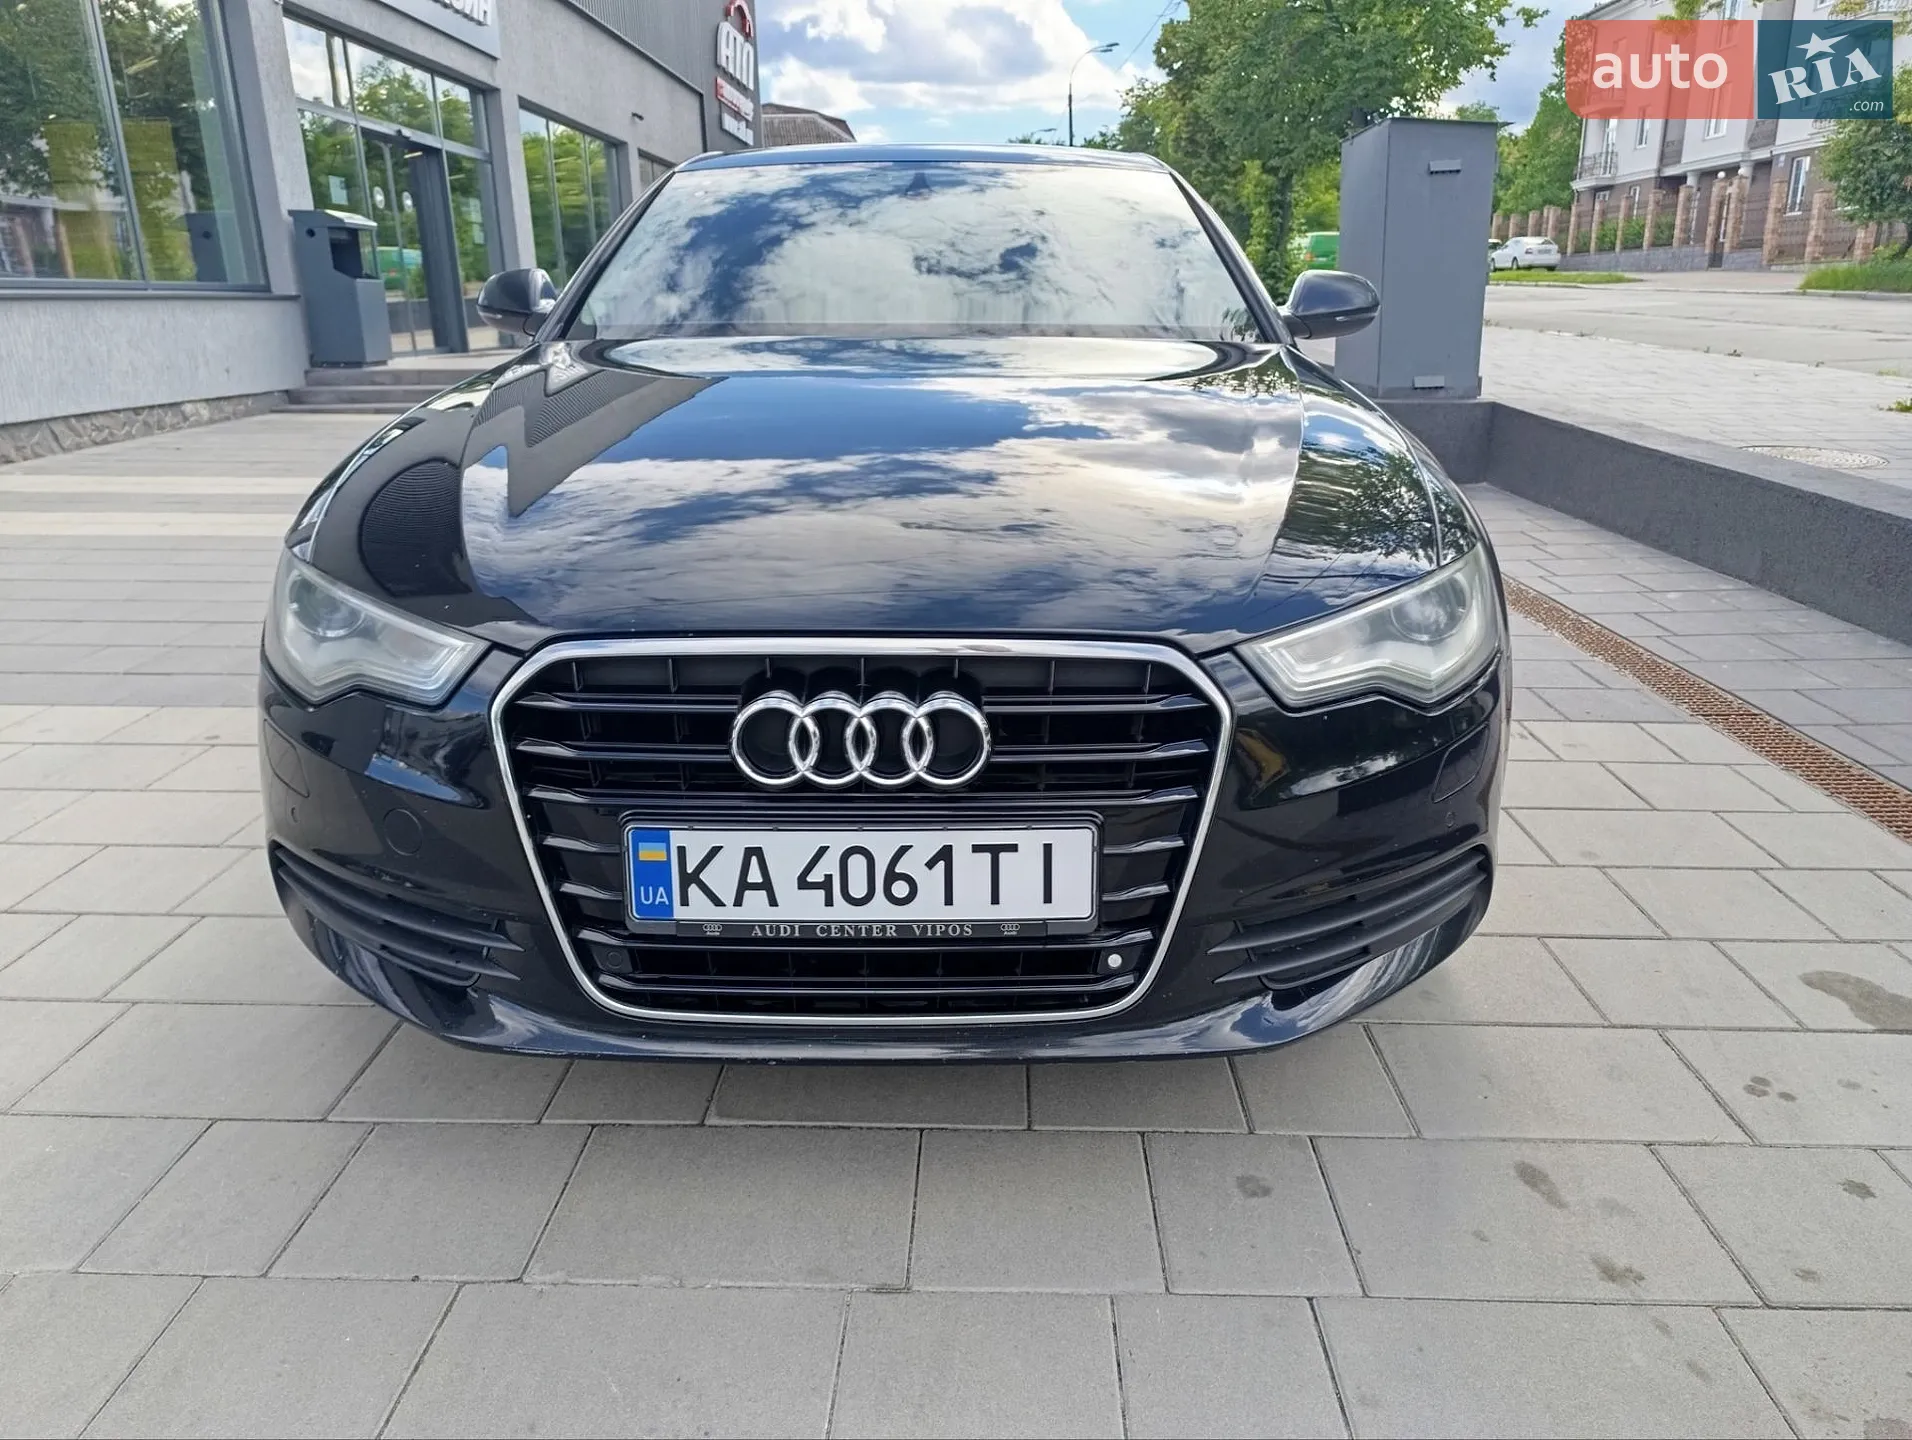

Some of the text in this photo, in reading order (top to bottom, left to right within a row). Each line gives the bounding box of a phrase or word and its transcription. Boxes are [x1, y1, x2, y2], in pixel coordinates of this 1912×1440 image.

[677, 843, 1053, 907] KA 4061 TI
[640, 886, 669, 905] UA
[752, 924, 973, 937] AUDI CENTER VIPOS
